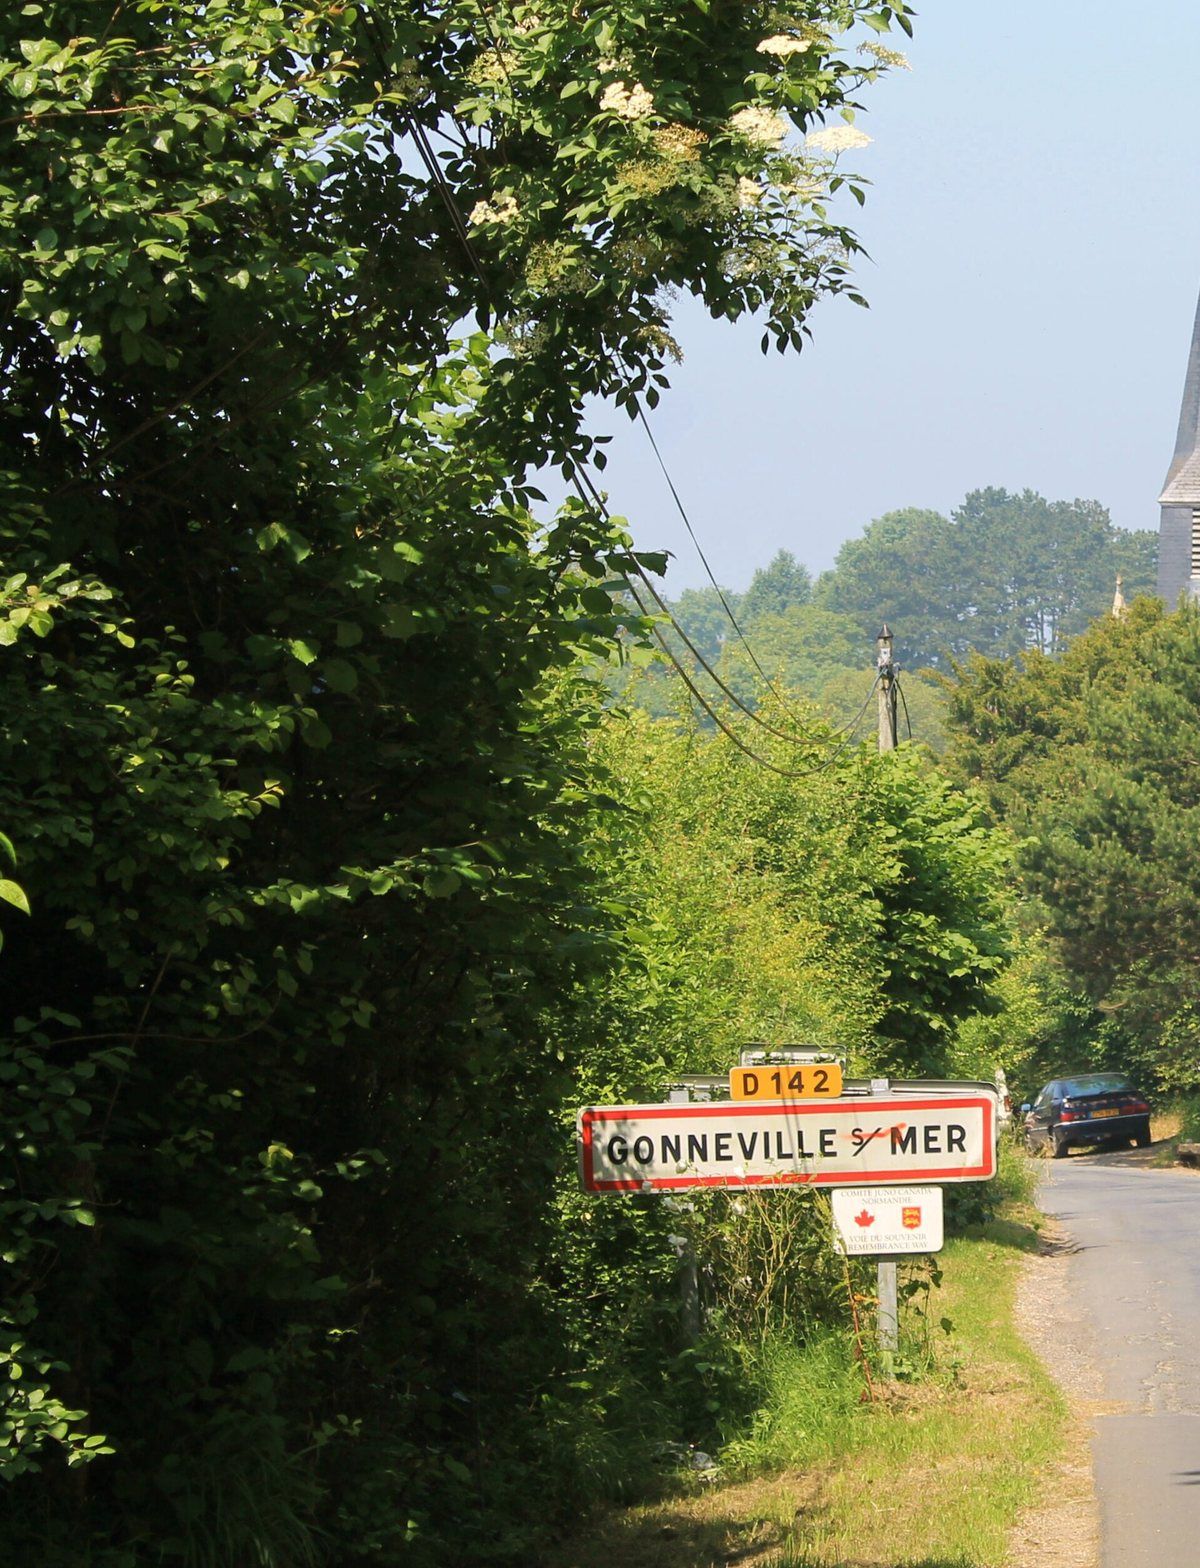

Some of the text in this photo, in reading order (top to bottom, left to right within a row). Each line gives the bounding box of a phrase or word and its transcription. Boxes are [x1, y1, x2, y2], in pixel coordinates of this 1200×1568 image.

[742, 1069, 829, 1096] D 142
[607, 1128, 837, 1166] GONNEVILLE
[874, 1188, 897, 1197] JUNO
[898, 1187, 932, 1195] CANADA
[862, 1197, 913, 1205] NORMANDIE
[871, 1234, 883, 1242] DU
[884, 1232, 927, 1242] SOUVENIR
[848, 1242, 929, 1252] REMEMBRANCE WAY
